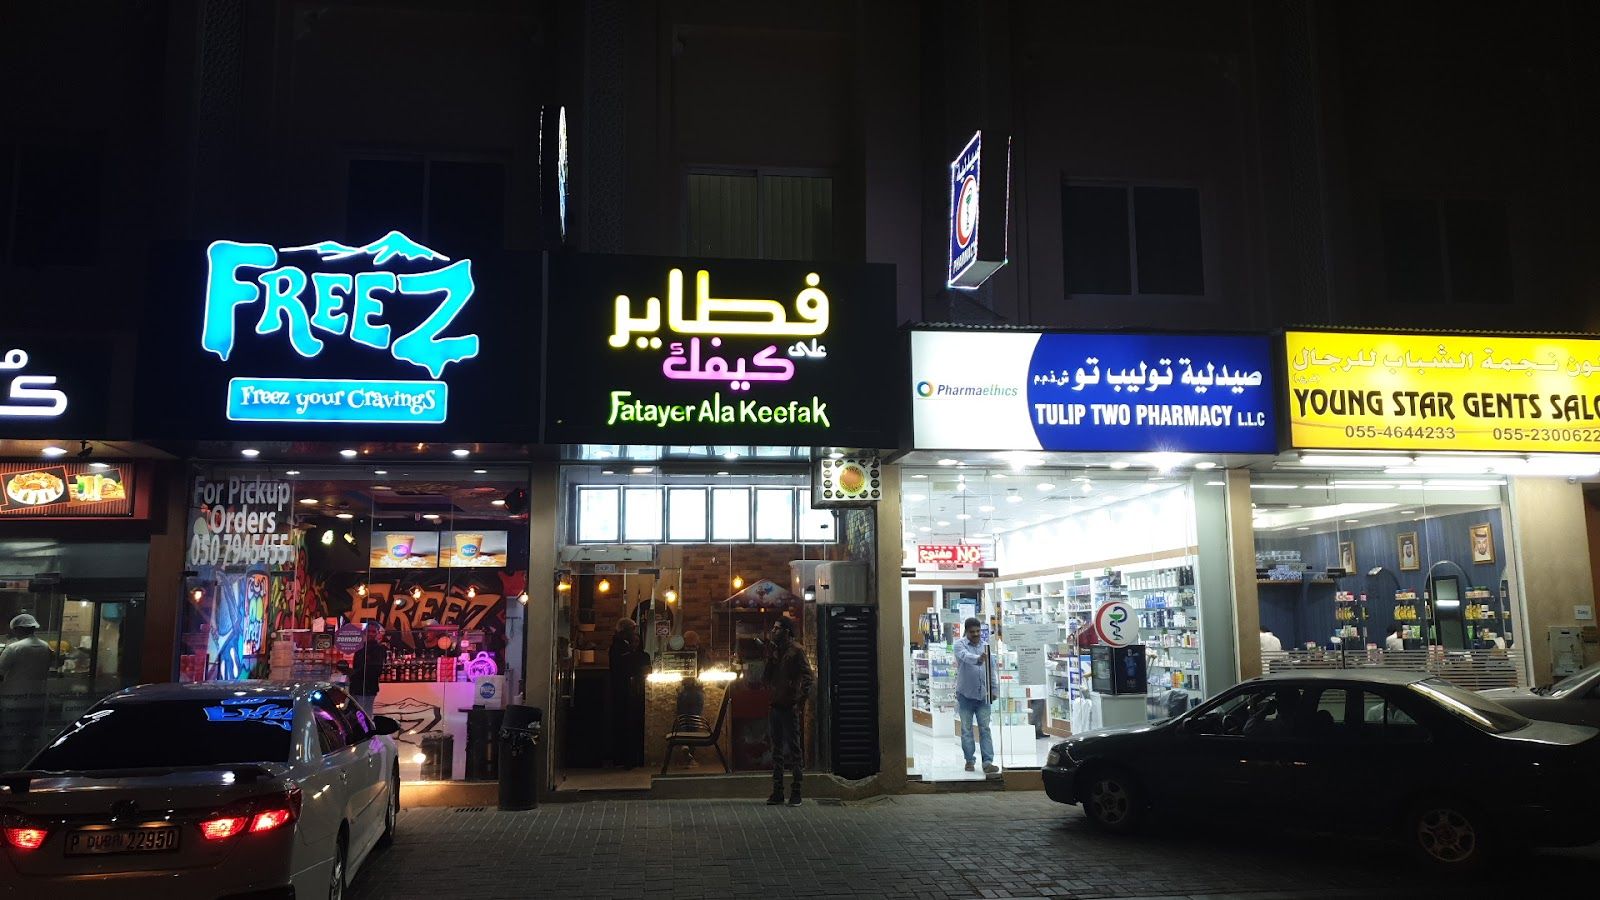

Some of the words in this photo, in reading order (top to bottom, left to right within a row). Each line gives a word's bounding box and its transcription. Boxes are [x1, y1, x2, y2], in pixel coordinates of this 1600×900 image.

[201, 240, 479, 379] FREEZ
[608, 268, 829, 349] فطاير
[787, 337, 828, 357] على
[1292, 346, 1378, 373] للرجال
[1382, 343, 1474, 375] الشباب
[1480, 347, 1560, 377] نجمة
[936, 382, 1019, 398] Pharmaethics
[1073, 356, 1100, 393] تو
[1106, 358, 1174, 393] توليب
[1179, 357, 1263, 394] صيدلية
[240, 385, 290, 406] Freez
[296, 390, 346, 415] your
[347, 387, 436, 415] Cravings
[608, 390, 696, 427] Fatayer
[698, 391, 735, 422] Ala
[740, 396, 830, 427] Keefak
[1035, 403, 1086, 425] TULIP
[1091, 404, 1131, 426] TWO
[1136, 404, 1233, 427] PHARMACY
[1238, 412, 1266, 427] L.L.C
[1293, 388, 1384, 418] YOUNG
[1392, 391, 1456, 420] STAR
[1463, 392, 1543, 420] GENTS
[1344, 425, 1457, 440] 055-4644233
[194, 476, 224, 504] For
[228, 475, 291, 511] Pickup
[210, 504, 276, 534] Orders
[191, 534, 220, 566] 050
[71, 835, 79, 850] P
[127, 830, 175, 850] 22950
